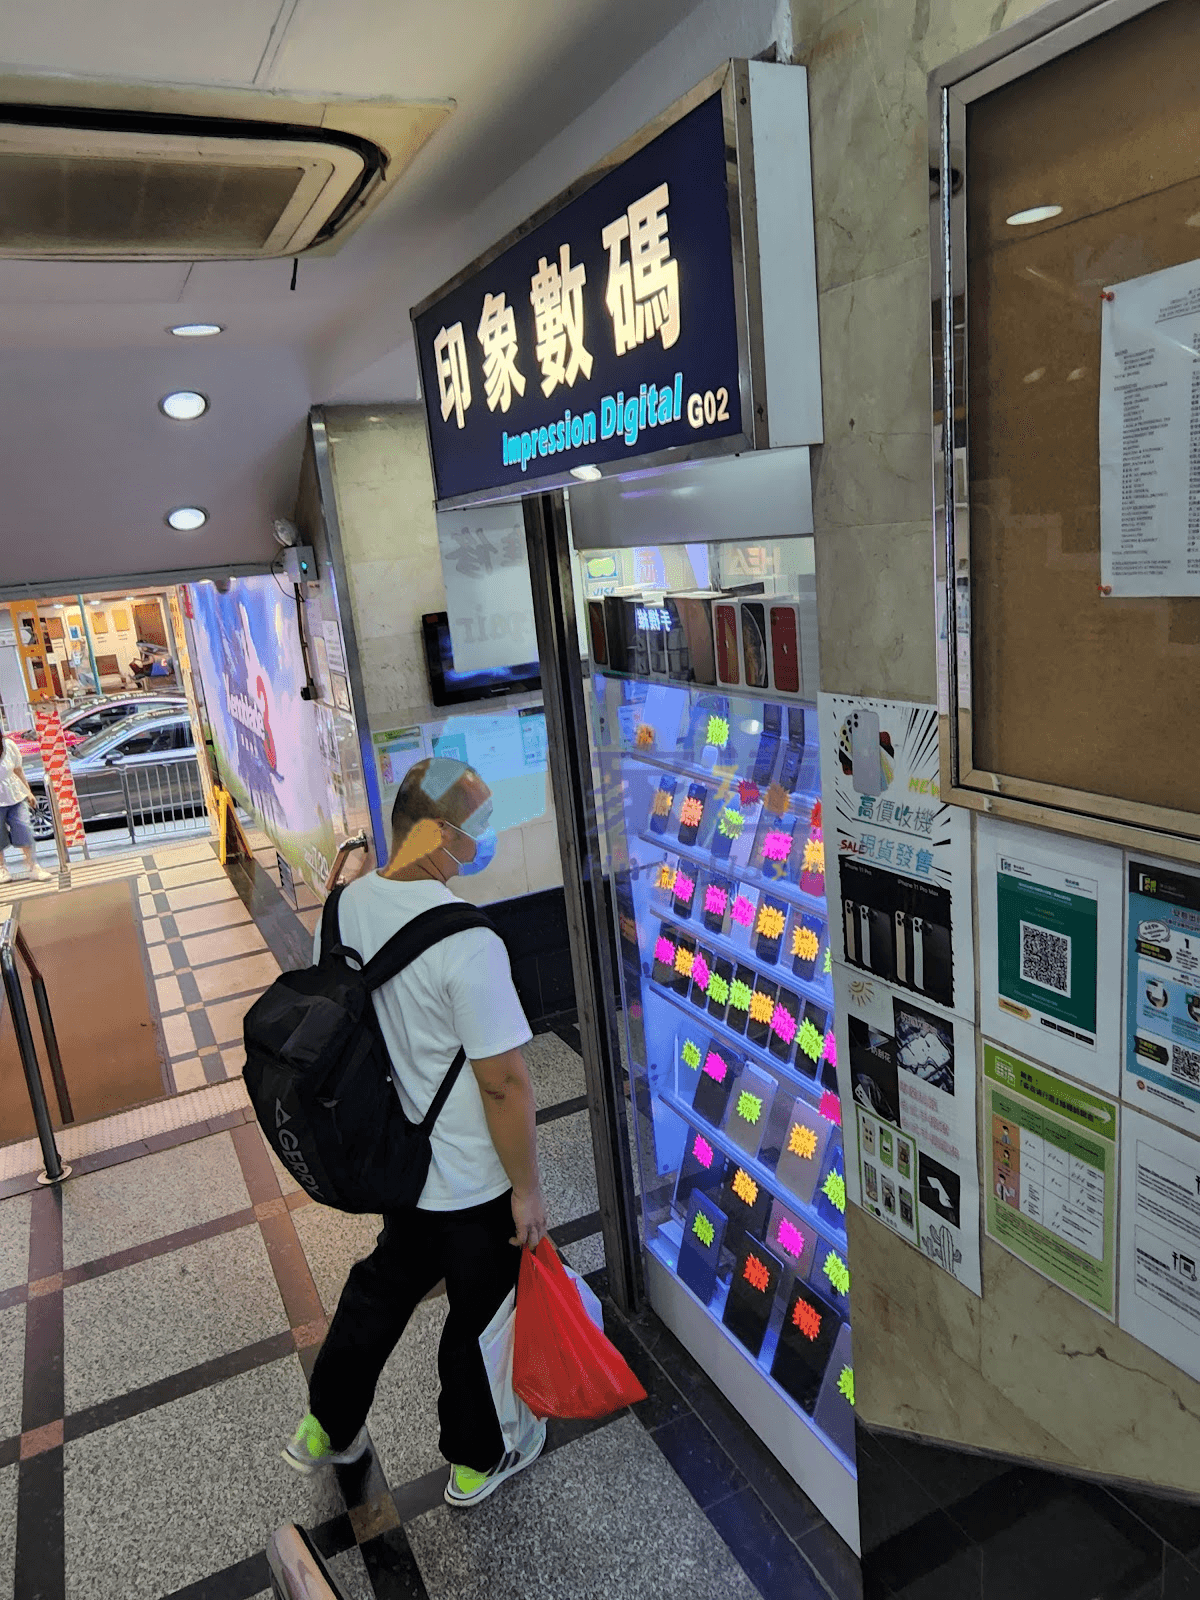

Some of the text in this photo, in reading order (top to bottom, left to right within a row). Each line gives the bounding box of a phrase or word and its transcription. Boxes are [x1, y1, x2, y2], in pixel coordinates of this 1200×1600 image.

[433, 182, 681, 429] 印象數碼
[502, 372, 730, 472] Impression Digital G02
[858, 795, 934, 834] 高價收機
[840, 839, 868, 854] SALE
[860, 833, 934, 874] 現貨發售
